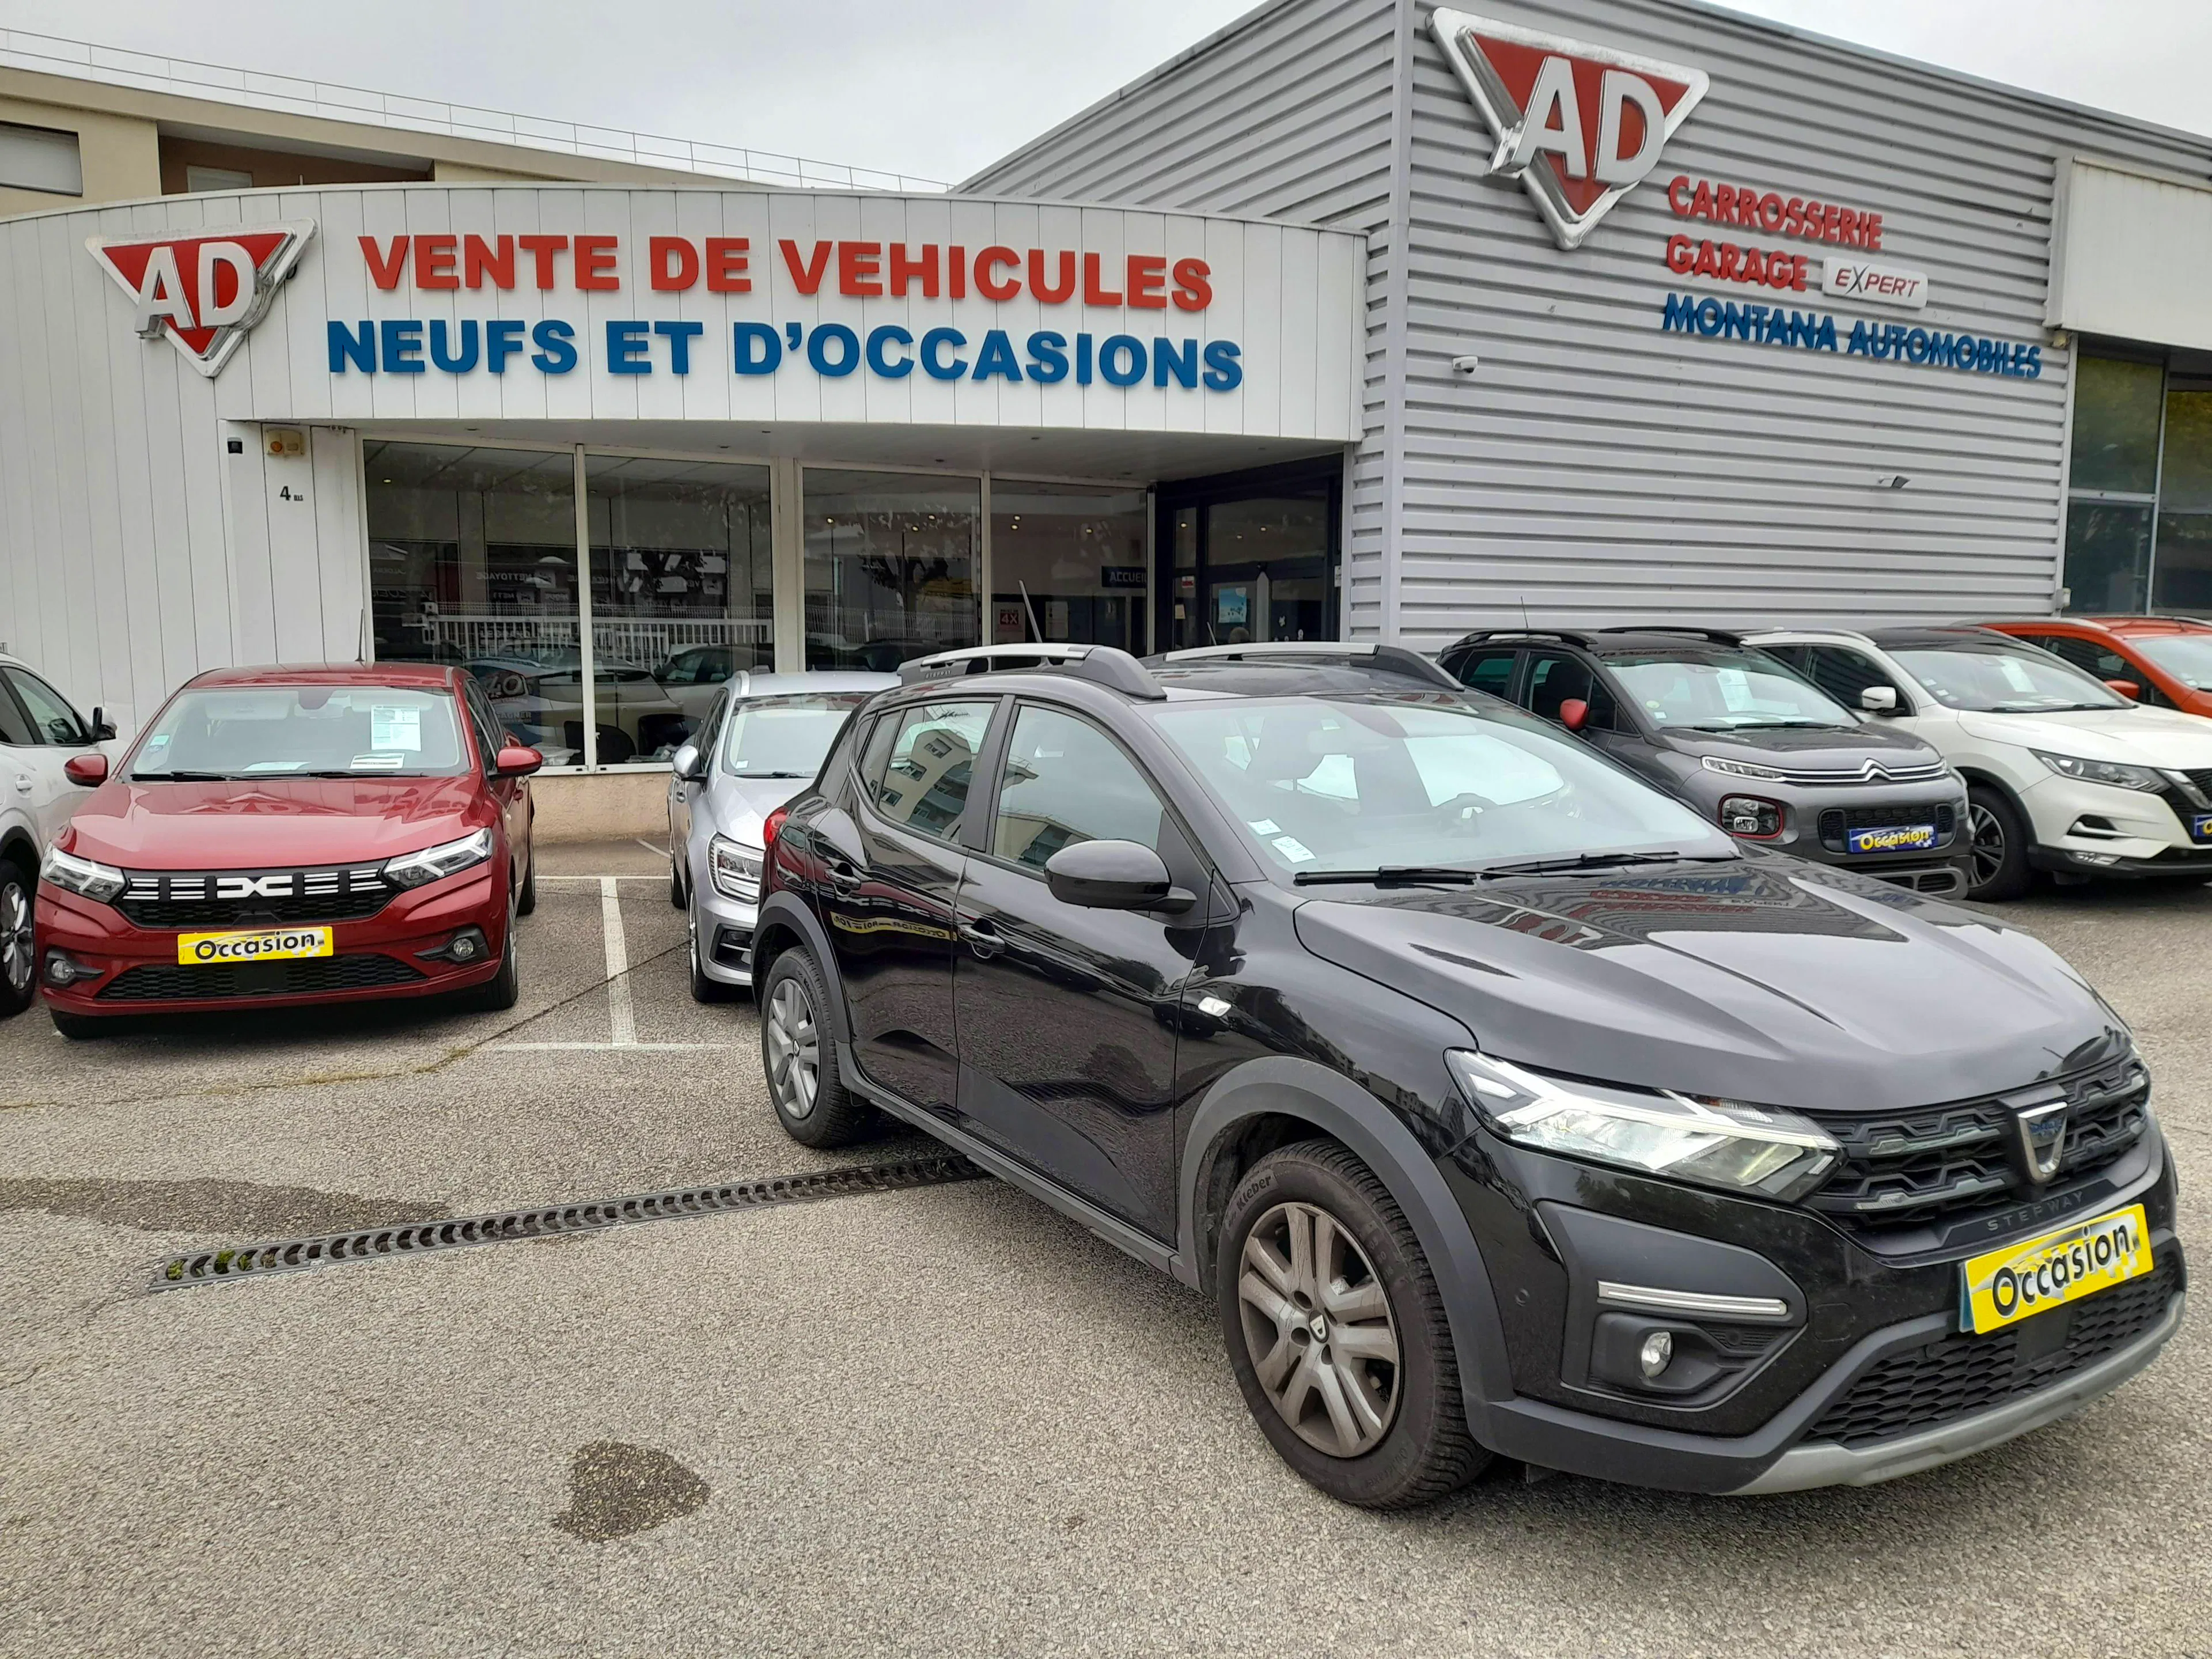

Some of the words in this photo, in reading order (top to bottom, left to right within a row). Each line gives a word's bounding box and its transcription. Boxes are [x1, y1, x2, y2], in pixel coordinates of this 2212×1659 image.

[1508, 55, 1665, 184] AD
[1668, 176, 1884, 250] CARROSSERIE
[133, 240, 259, 334] AD
[357, 234, 620, 290] VENTE
[649, 236, 752, 292] DE
[778, 239, 1213, 312] VEHICULES
[1666, 233, 1809, 292] GARAGE
[1834, 263, 1921, 298] EXPERT
[327, 320, 578, 374] NEUFS
[605, 320, 703, 374] ET
[733, 321, 1243, 391] D'OCCASIONS
[1662, 293, 1838, 352] MONTANA
[1847, 320, 2042, 379] AUTOMOBILES
[279, 485, 291, 501] 4
[1859, 826, 1930, 851] Occasion
[194, 930, 316, 960] Occasion
[1236, 1176, 1271, 1211] Kleber
[1991, 1222, 2131, 1318] Occasion
